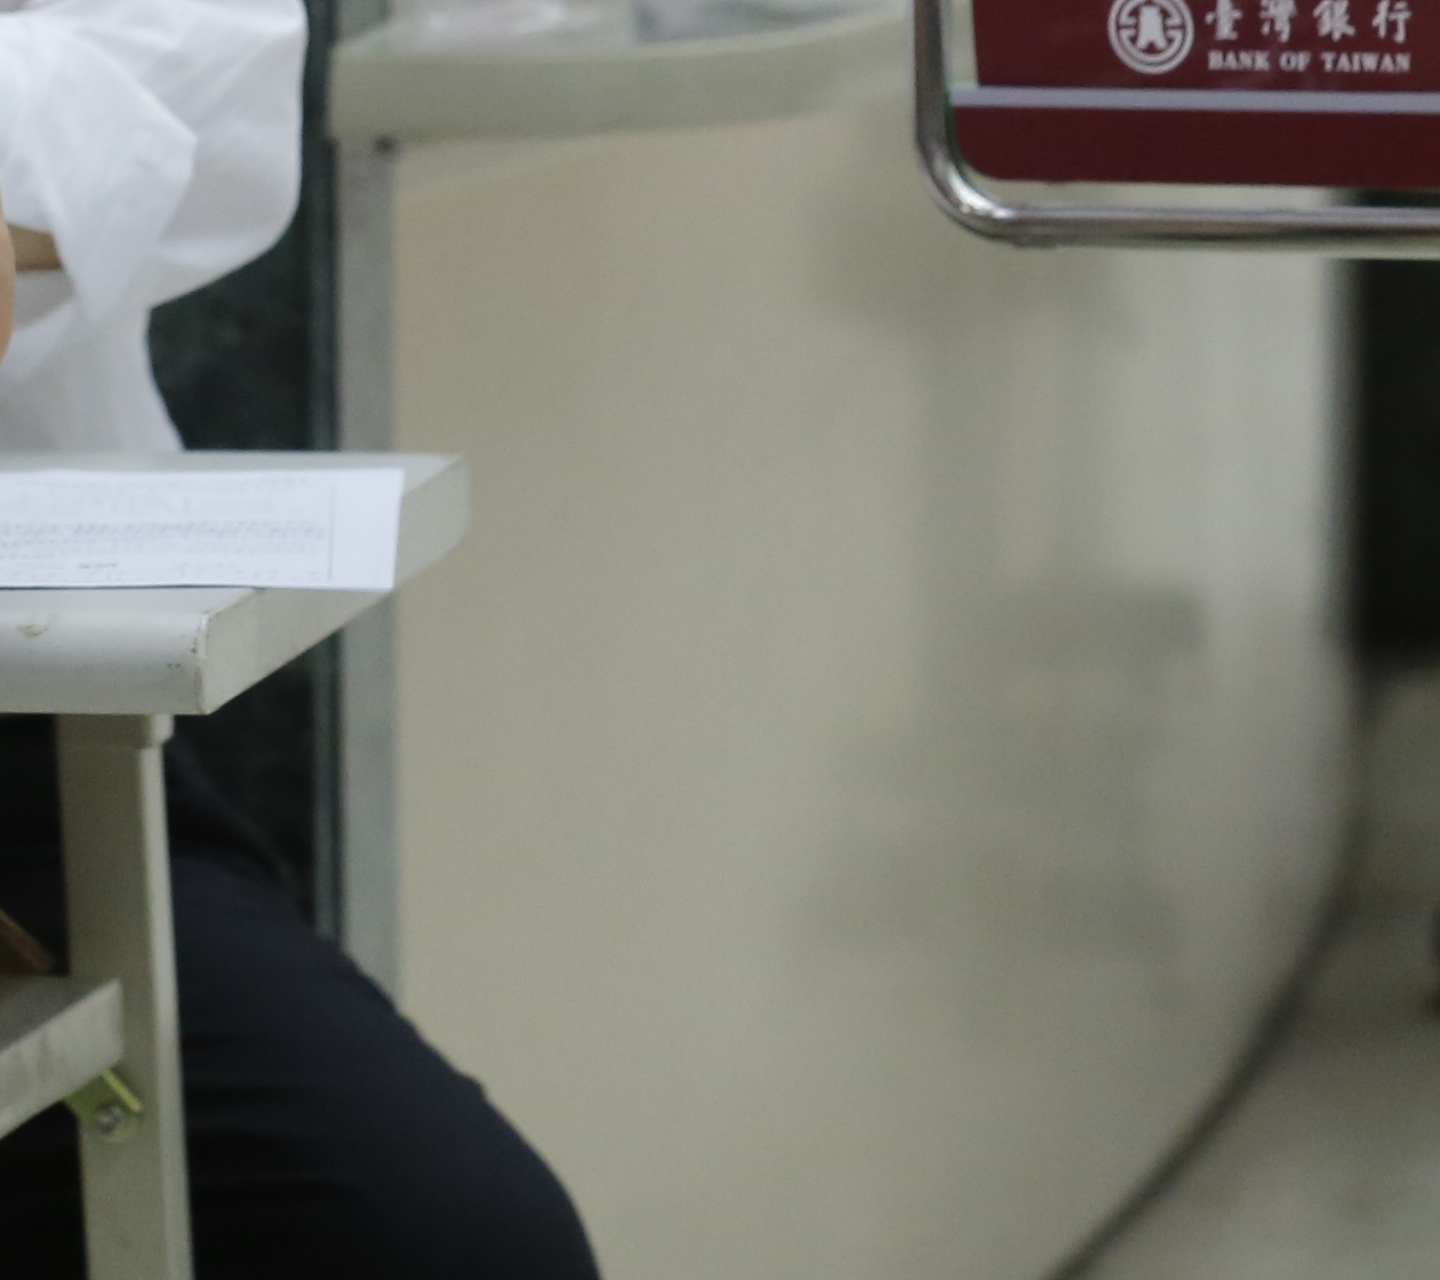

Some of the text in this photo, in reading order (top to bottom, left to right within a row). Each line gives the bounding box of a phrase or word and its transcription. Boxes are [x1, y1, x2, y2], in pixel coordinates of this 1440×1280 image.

[1208, 51, 1411, 74] BANK OF TAIWAN
